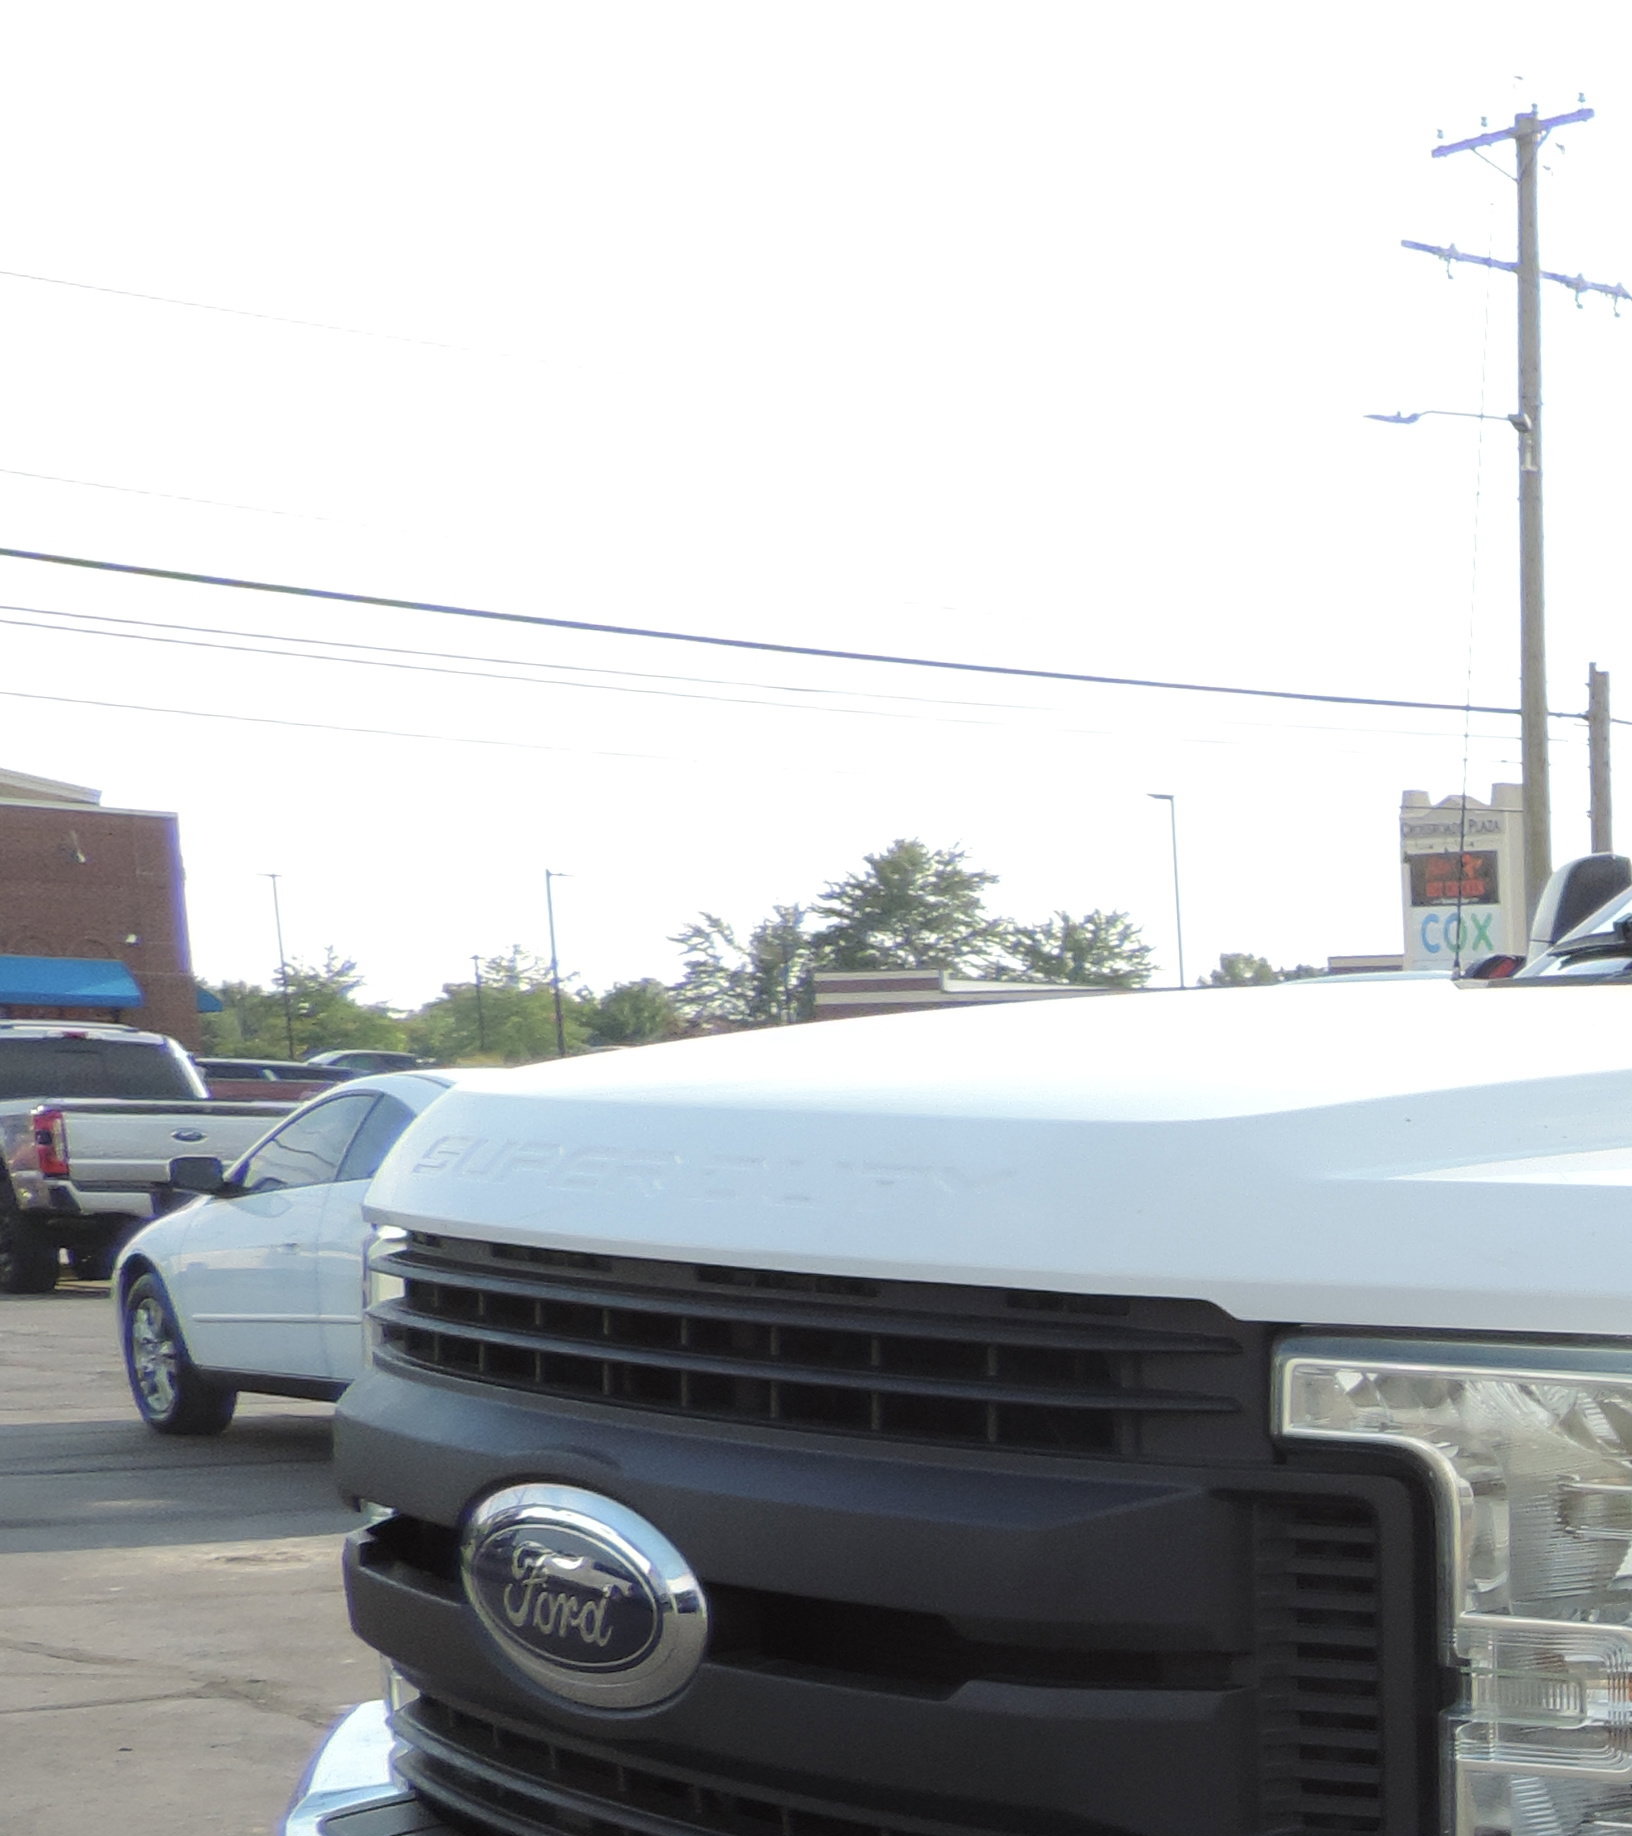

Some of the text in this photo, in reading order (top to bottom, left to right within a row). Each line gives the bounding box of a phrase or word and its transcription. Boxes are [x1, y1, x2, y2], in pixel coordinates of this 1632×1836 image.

[1468, 818, 1501, 834] PLAZA
[1420, 912, 1495, 954] COX
[503, 1540, 615, 1648] Ford
